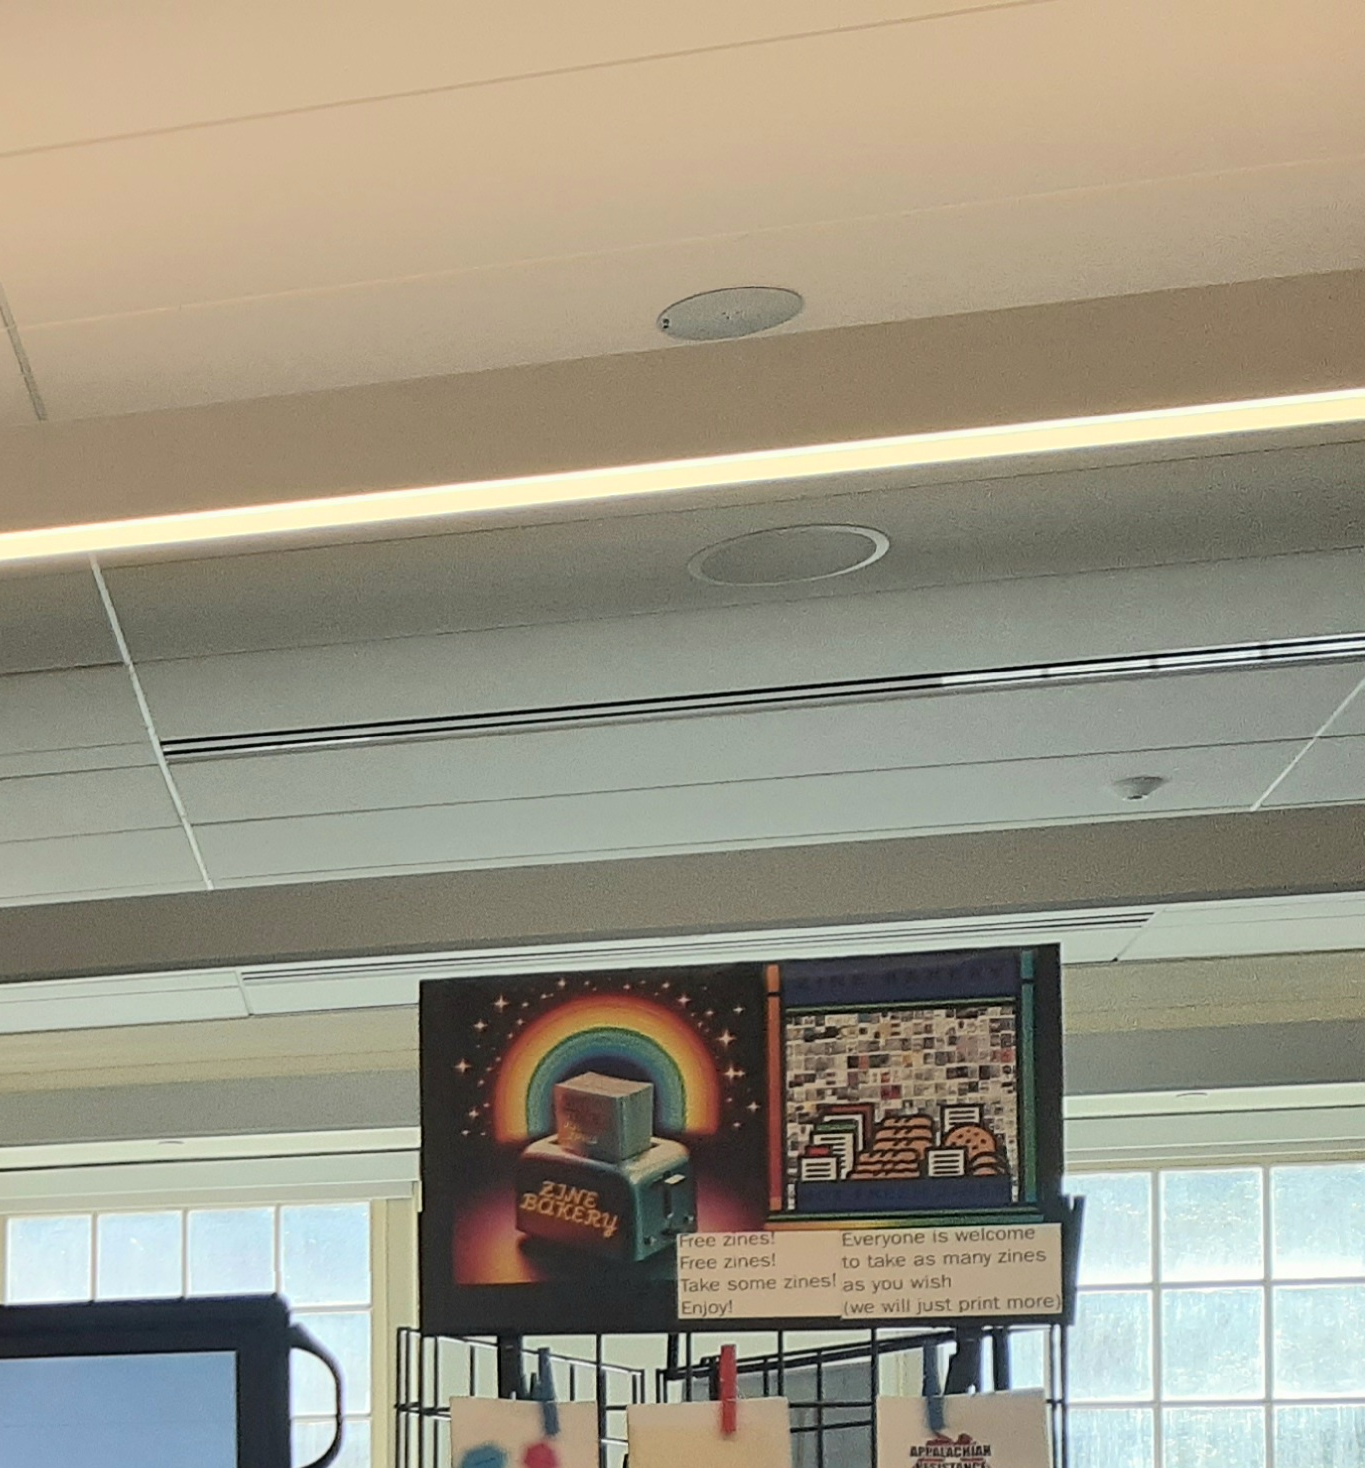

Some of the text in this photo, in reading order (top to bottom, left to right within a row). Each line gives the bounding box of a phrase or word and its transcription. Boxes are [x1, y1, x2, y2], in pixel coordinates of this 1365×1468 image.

[539, 1180, 598, 1208] ZINE
[680, 1232, 776, 1247] Free zines!
[842, 1227, 1035, 1249] Everyone is welcome
[681, 1253, 776, 1269] Free zines!
[842, 1249, 1047, 1269] to take as many zines
[681, 1274, 837, 1292] Take some zines!
[843, 1275, 952, 1294] as you wish
[681, 1300, 734, 1317] Enjoy!
[843, 1295, 1062, 1316] (we will just print more)
